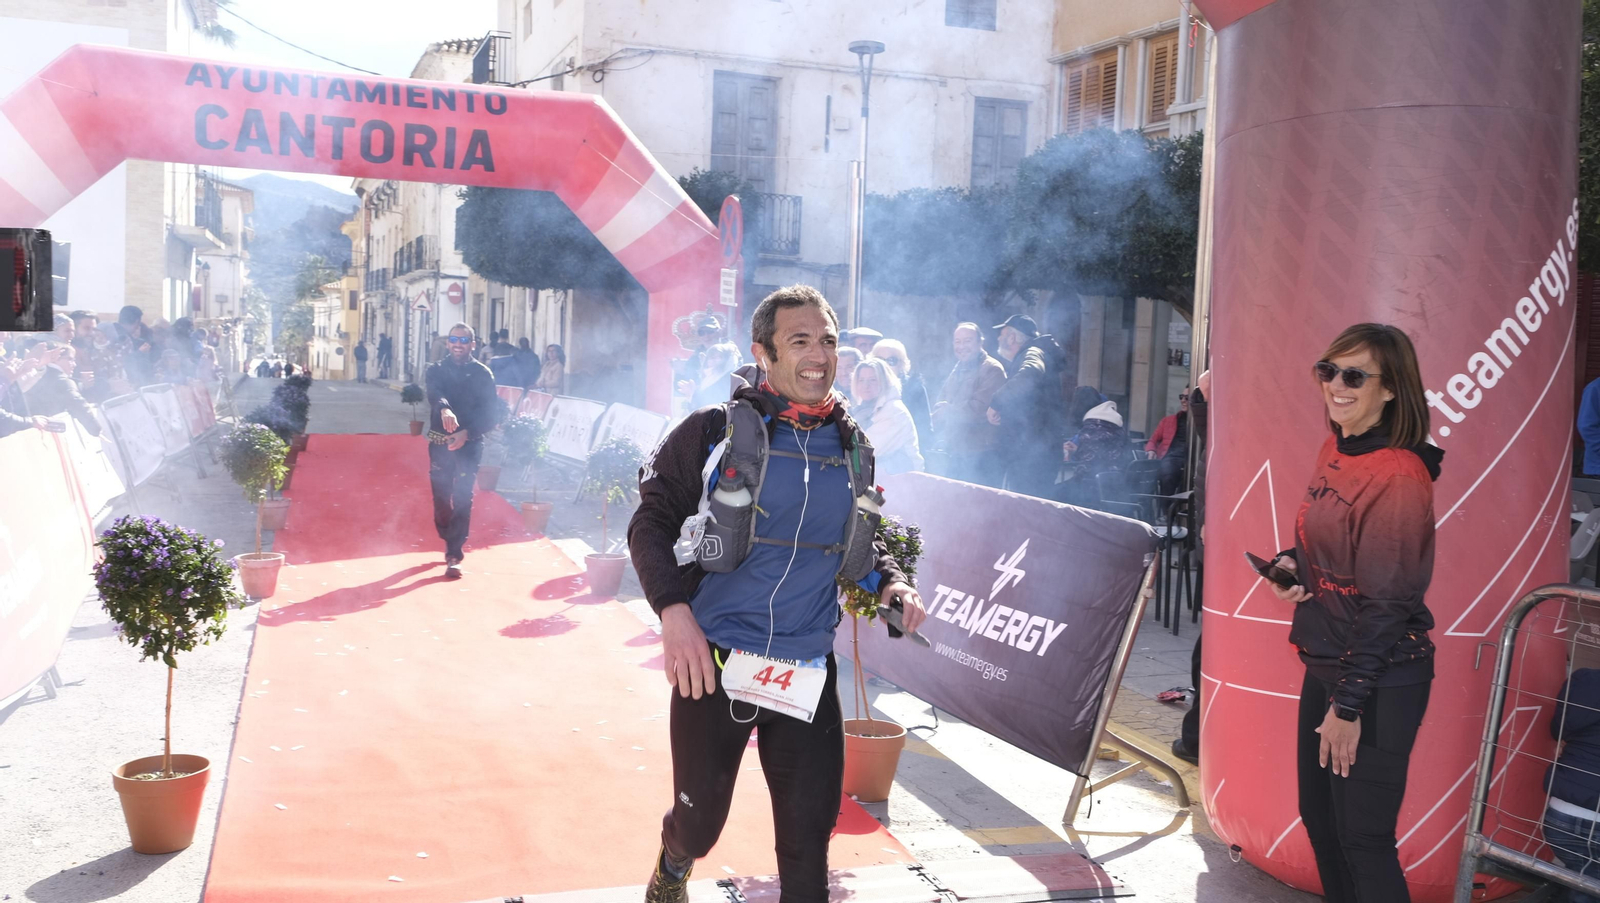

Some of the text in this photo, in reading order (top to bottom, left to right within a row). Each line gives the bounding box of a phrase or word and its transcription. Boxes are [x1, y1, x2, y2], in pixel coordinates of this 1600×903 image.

[185, 63, 508, 115] AYUNTAMIENTO
[194, 104, 496, 172] CANTORIA
[926, 584, 1068, 657] TEAMERGY
[753, 666, 795, 691] 44
[934, 641, 1009, 682] www.teamergy.es
